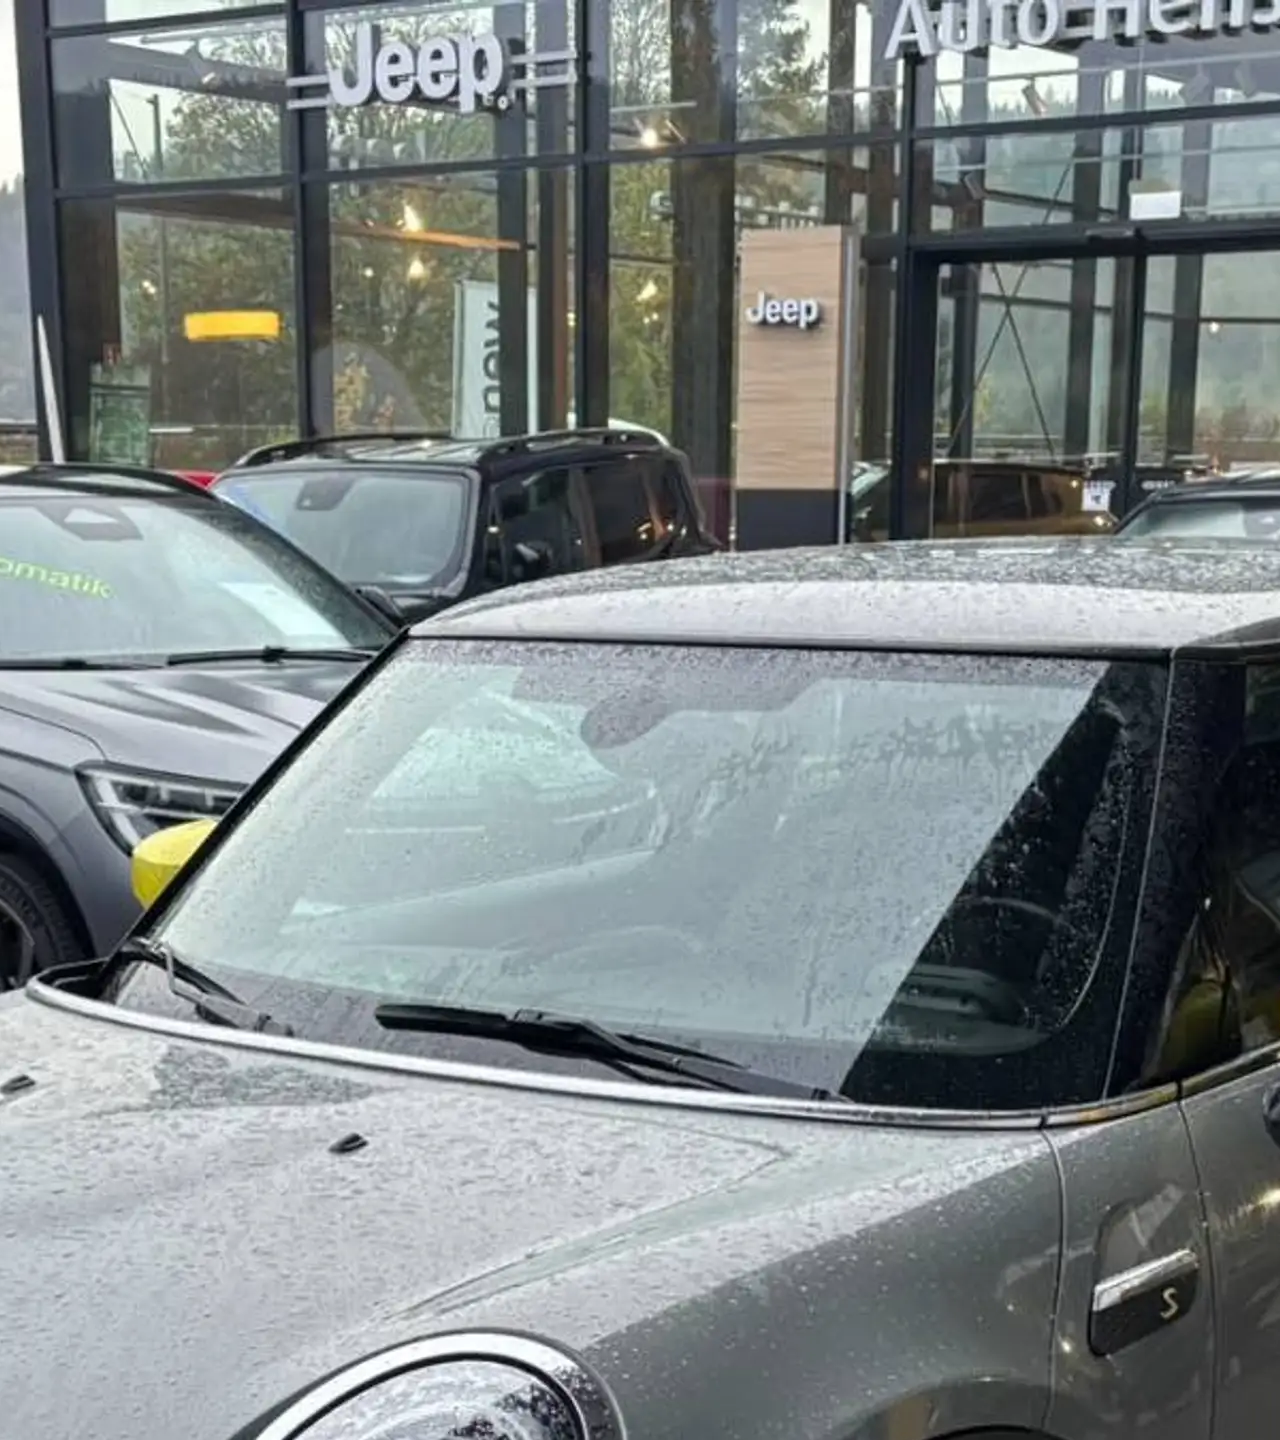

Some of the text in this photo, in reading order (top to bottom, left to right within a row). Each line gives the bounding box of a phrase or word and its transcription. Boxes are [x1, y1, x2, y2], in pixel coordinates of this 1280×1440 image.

[327, 21, 503, 113] Jeep
[744, 290, 819, 330] Jeep
[1160, 1287, 1179, 1319] S
